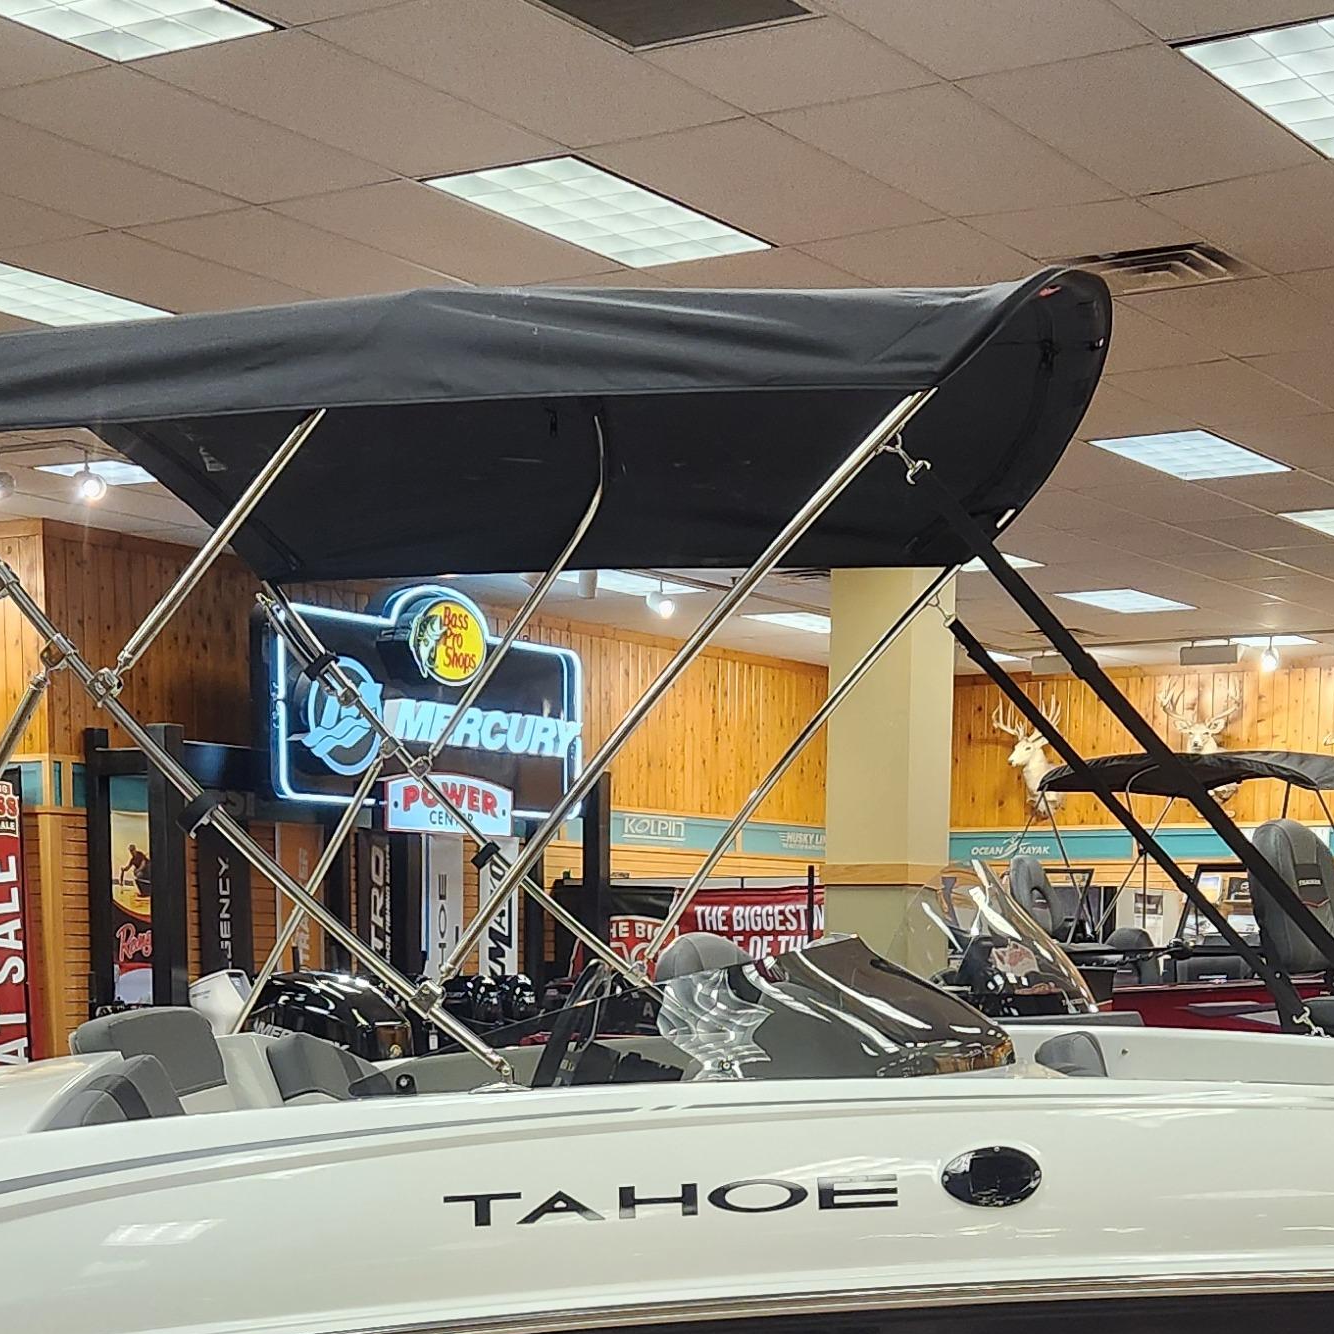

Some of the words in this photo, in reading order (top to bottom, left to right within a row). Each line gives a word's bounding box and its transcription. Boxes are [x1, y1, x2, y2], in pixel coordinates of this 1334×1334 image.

[443, 606, 468, 629] Bass
[443, 627, 463, 649] Pro
[443, 648, 477, 673] Shops
[394, 699, 581, 758] MERCURY
[402, 782, 499, 820] POWER
[971, 846, 1003, 856] OCEAN
[1018, 846, 1050, 855] KAYAK
[694, 905, 730, 931] THE
[732, 905, 808, 932] BIGGEST
[443, 1173, 899, 1227] TAHOE
